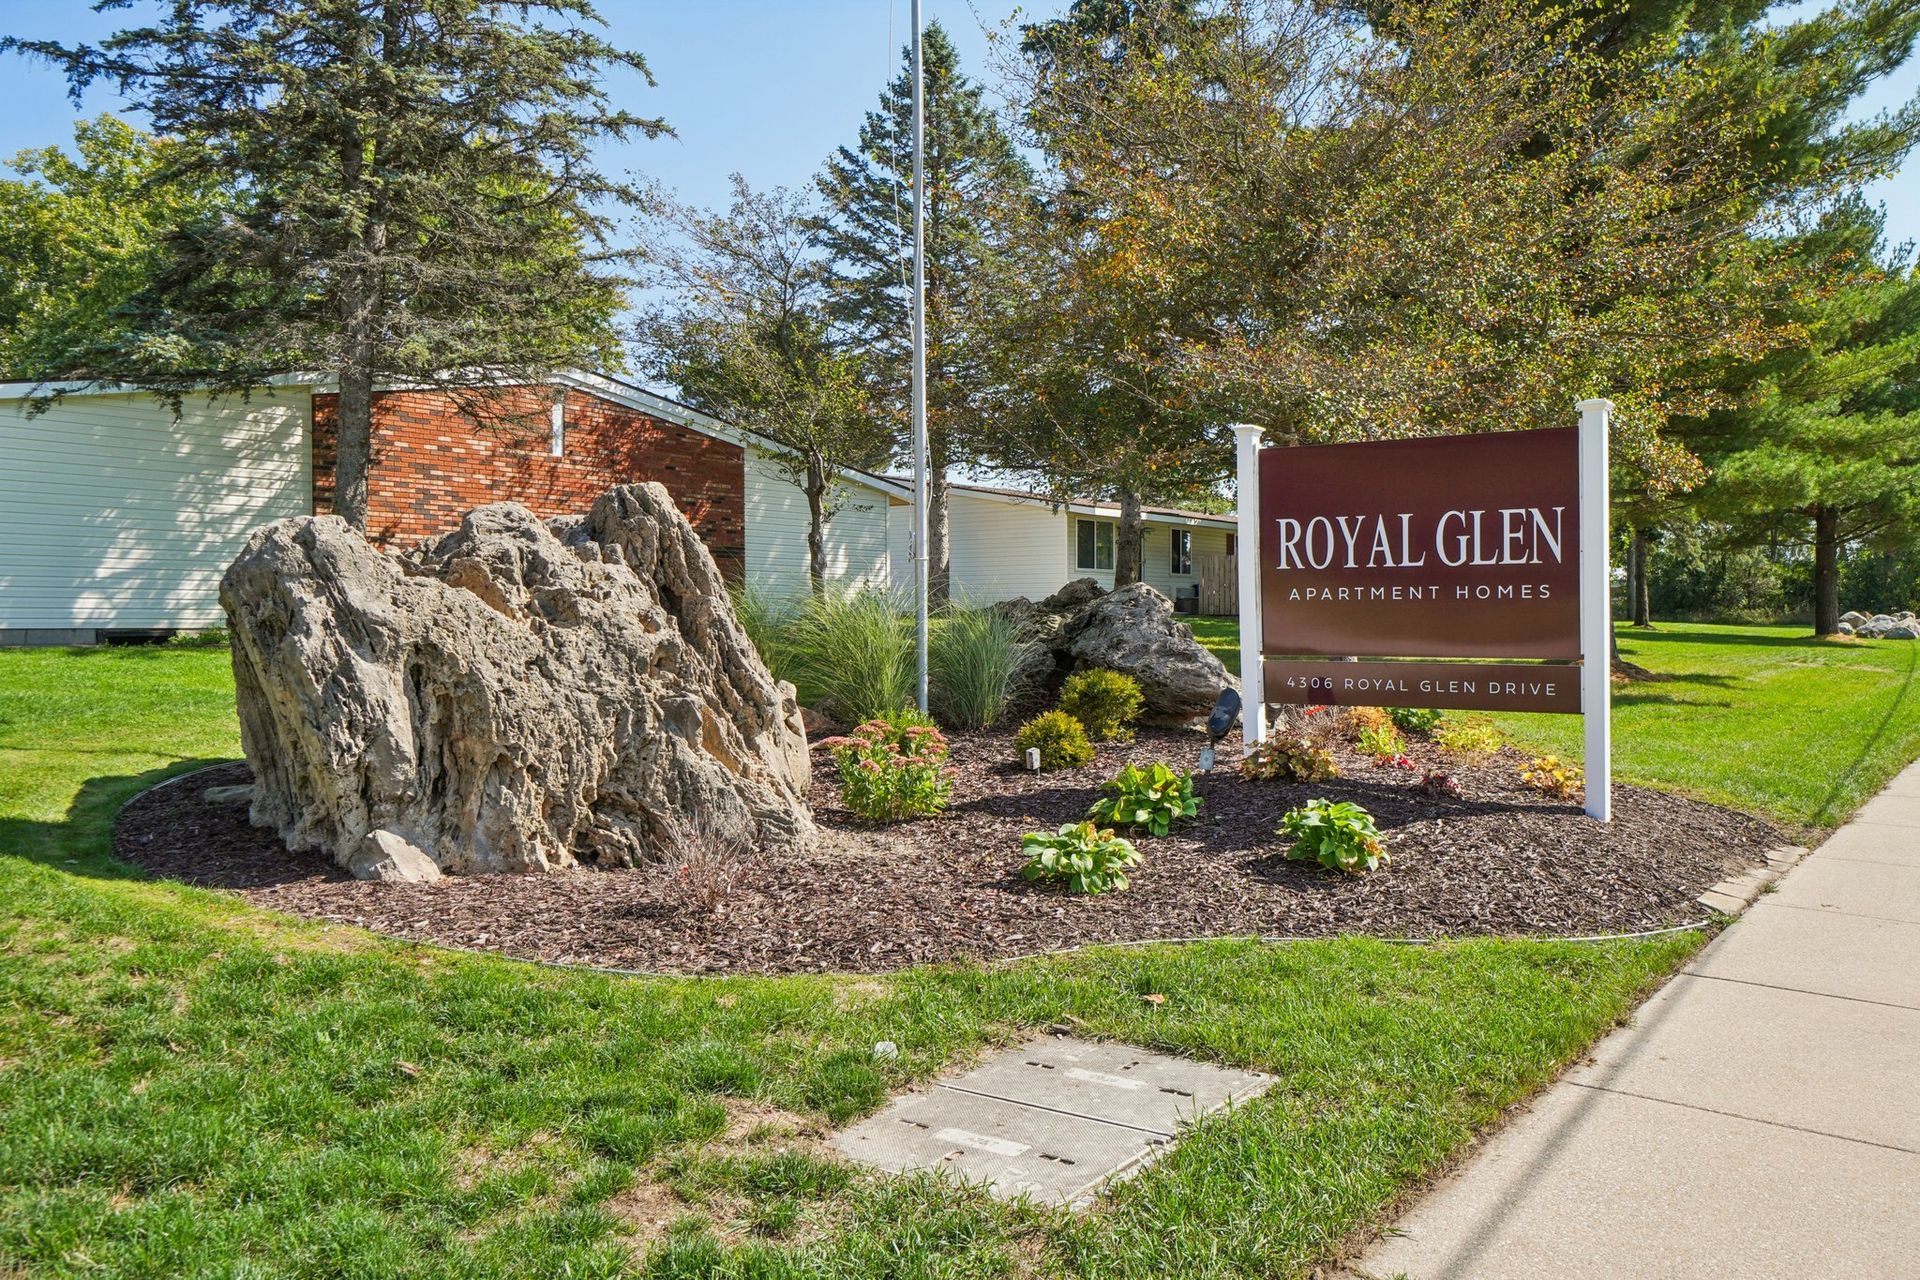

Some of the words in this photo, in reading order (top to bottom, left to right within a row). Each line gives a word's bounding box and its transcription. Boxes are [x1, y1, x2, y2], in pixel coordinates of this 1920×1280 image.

[1275, 513, 1426, 570] ROYAL
[1435, 506, 1566, 567] GLEN
[1289, 586, 1440, 601] APARTMENT
[1456, 584, 1550, 599] HOMES
[1286, 676, 1333, 689] 4306
[1344, 678, 1408, 692] ROYAL
[1419, 680, 1475, 693] GLEN
[1489, 681, 1556, 696] DRIVE
